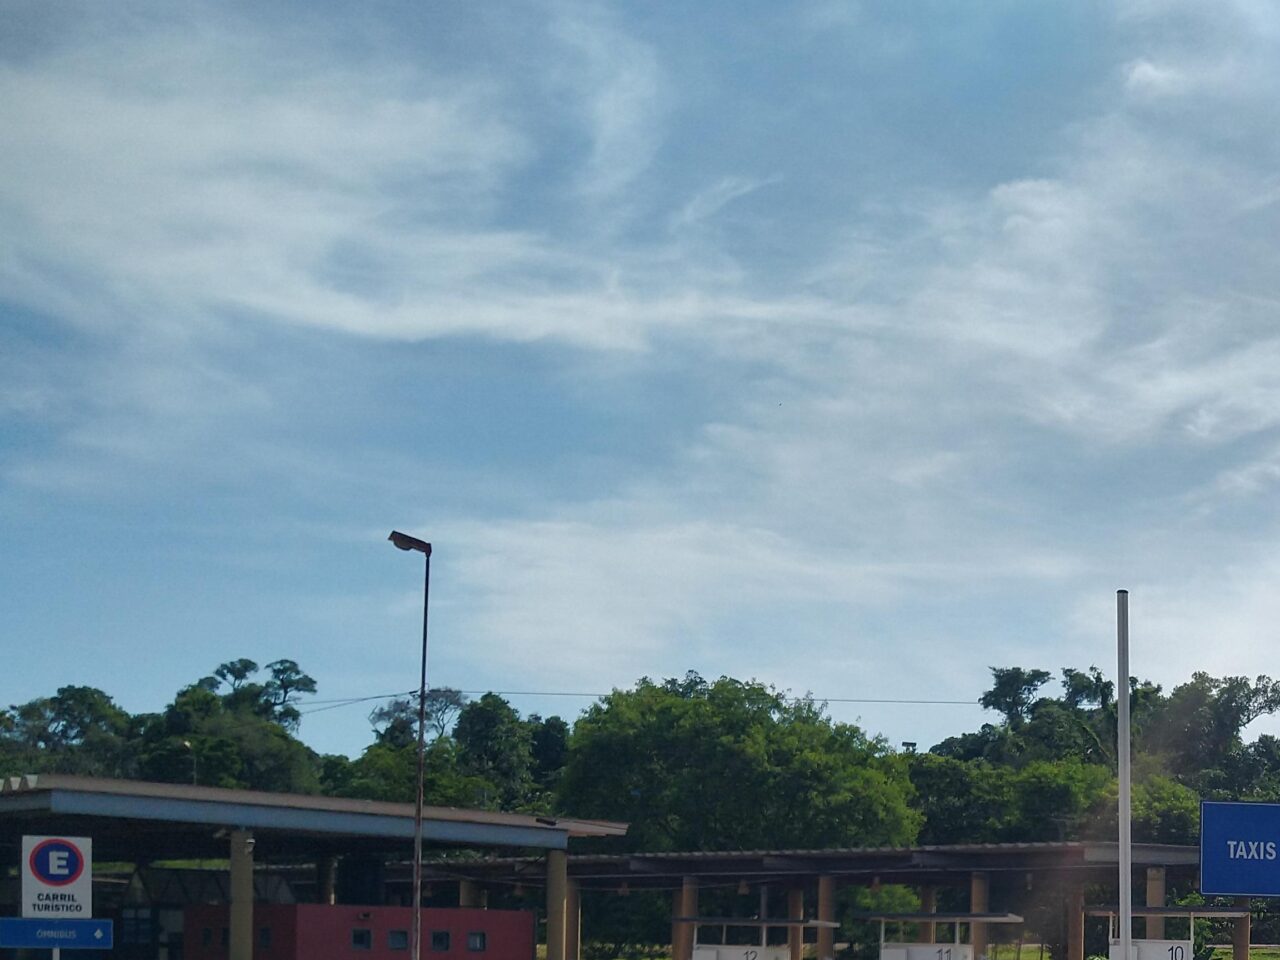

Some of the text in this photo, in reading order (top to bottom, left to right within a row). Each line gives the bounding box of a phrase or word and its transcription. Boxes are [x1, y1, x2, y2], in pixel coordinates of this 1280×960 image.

[1227, 840, 1277, 860] TAXIS
[48, 850, 70, 875] E
[37, 892, 77, 902] CARRIL
